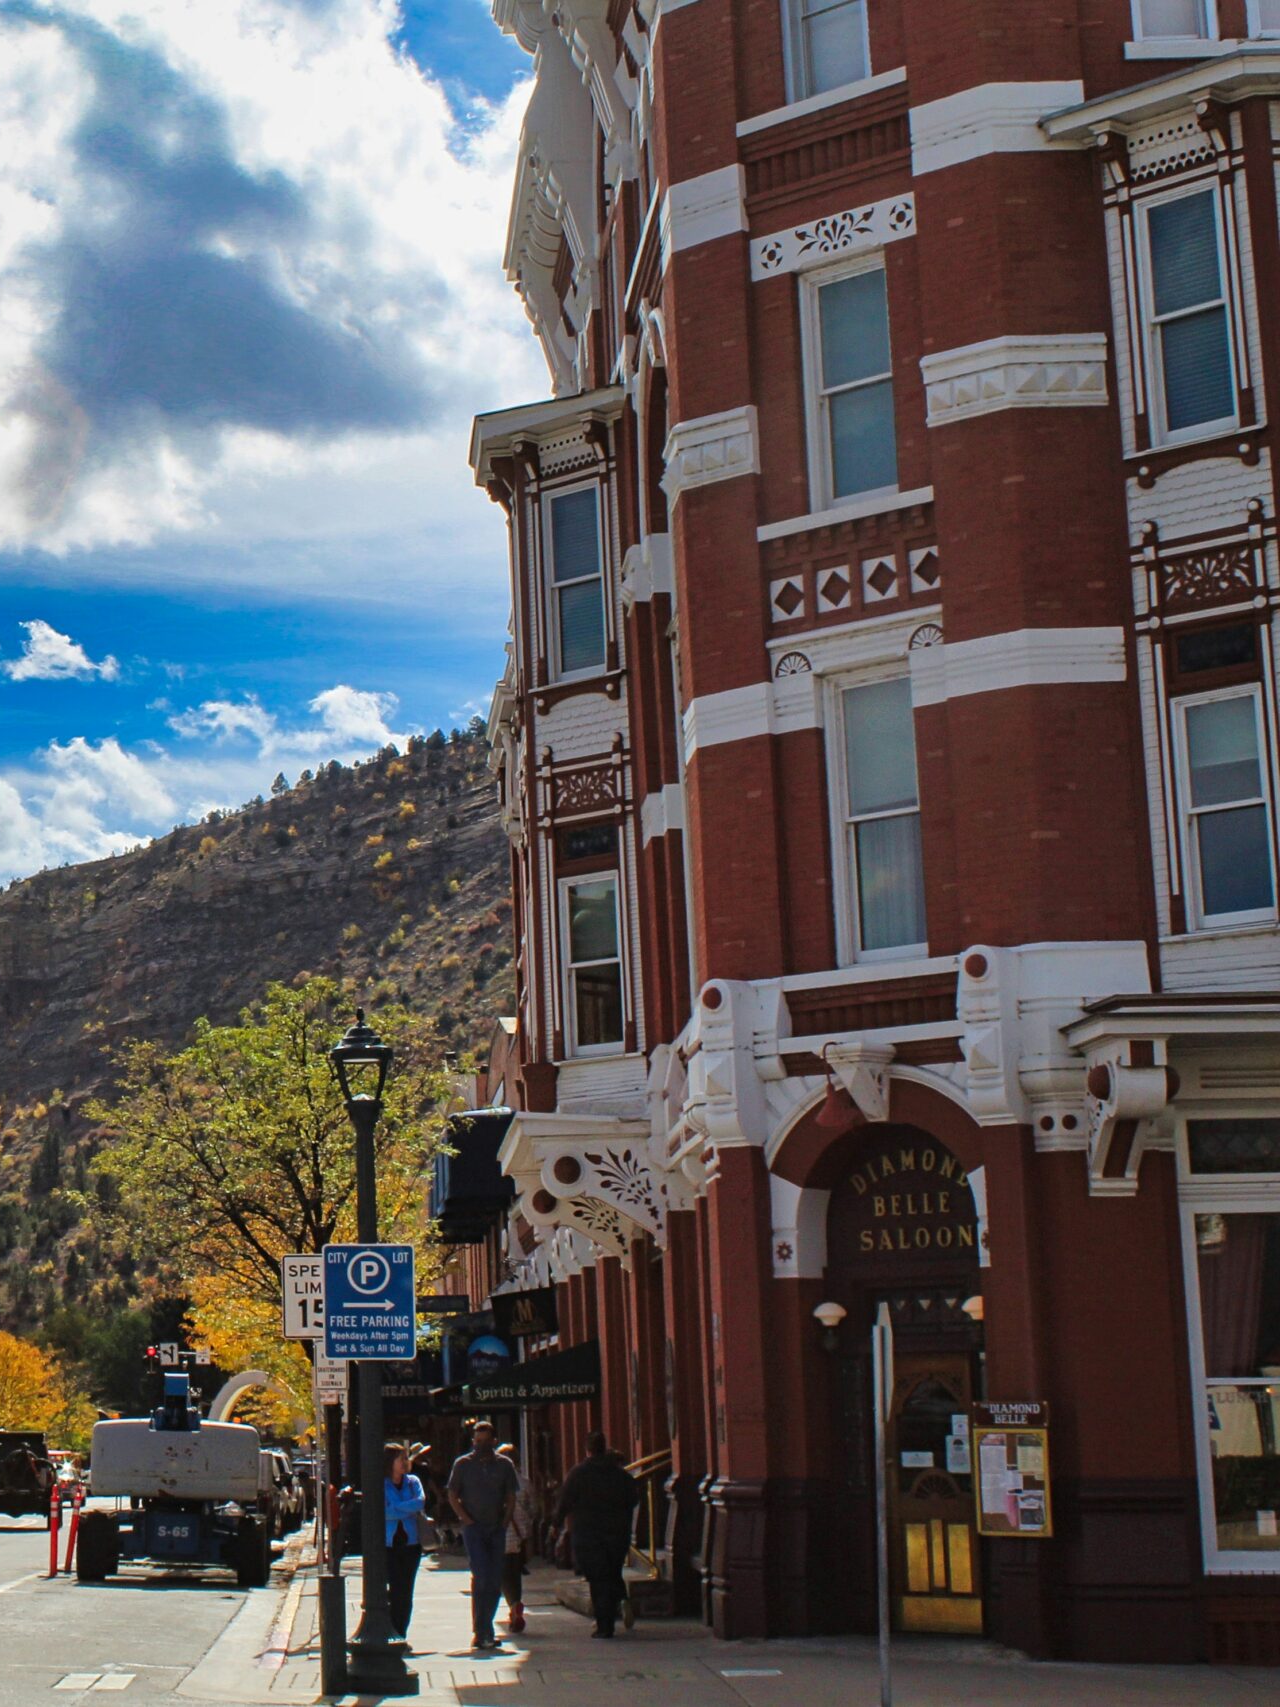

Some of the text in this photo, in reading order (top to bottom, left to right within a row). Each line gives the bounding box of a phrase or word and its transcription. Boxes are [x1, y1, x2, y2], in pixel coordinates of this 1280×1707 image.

[873, 1192, 950, 1217] BELLE
[859, 1224, 974, 1251] SALOON
[328, 1252, 409, 1264] CITY LOT
[288, 1265, 320, 1277] SPE
[361, 1261, 379, 1285] P
[294, 1282, 322, 1294] LIM
[330, 1315, 409, 1327] FREE PARKING
[331, 1331, 409, 1341] Weekdays After 5pm
[335, 1344, 405, 1354] Sat & Sun All Day
[476, 1387, 514, 1400] Spirits
[517, 1387, 527, 1397] &
[530, 1383, 596, 1397] Appetizers
[990, 1404, 1041, 1414] DIAMOND
[994, 1414, 1028, 1424] BELLE
[157, 1525, 189, 1537] S-65
